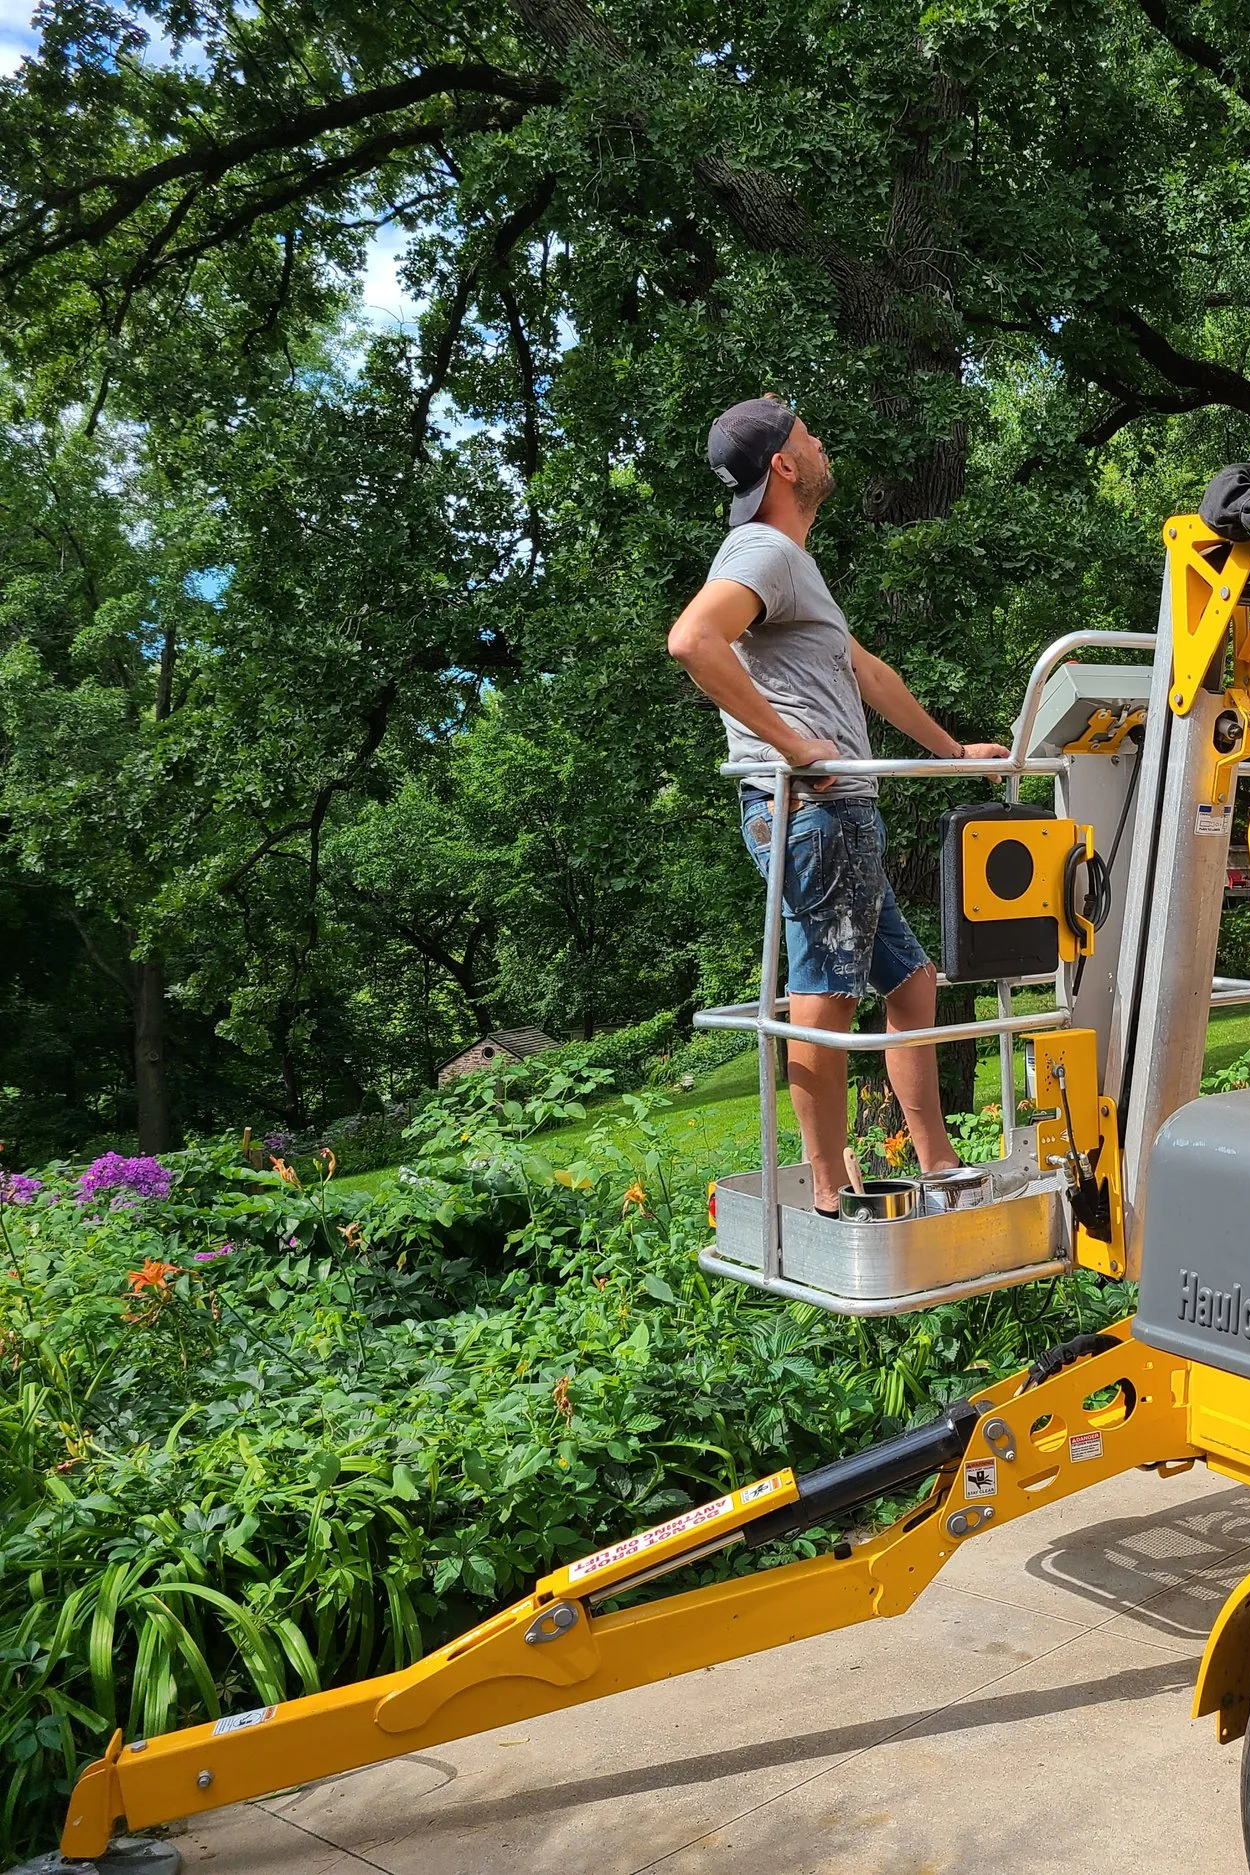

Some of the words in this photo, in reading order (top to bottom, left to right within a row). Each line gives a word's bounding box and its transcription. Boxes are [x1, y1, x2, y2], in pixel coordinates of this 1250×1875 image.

[1076, 1433, 1100, 1442] DANGER
[643, 1499, 727, 1542] ANYTHING
[693, 1509, 720, 1525] DO
[615, 1538, 640, 1554] ON
[645, 1524, 687, 1547] NOT
[573, 1551, 610, 1573] LIFT
[583, 1545, 639, 1574] DROP
